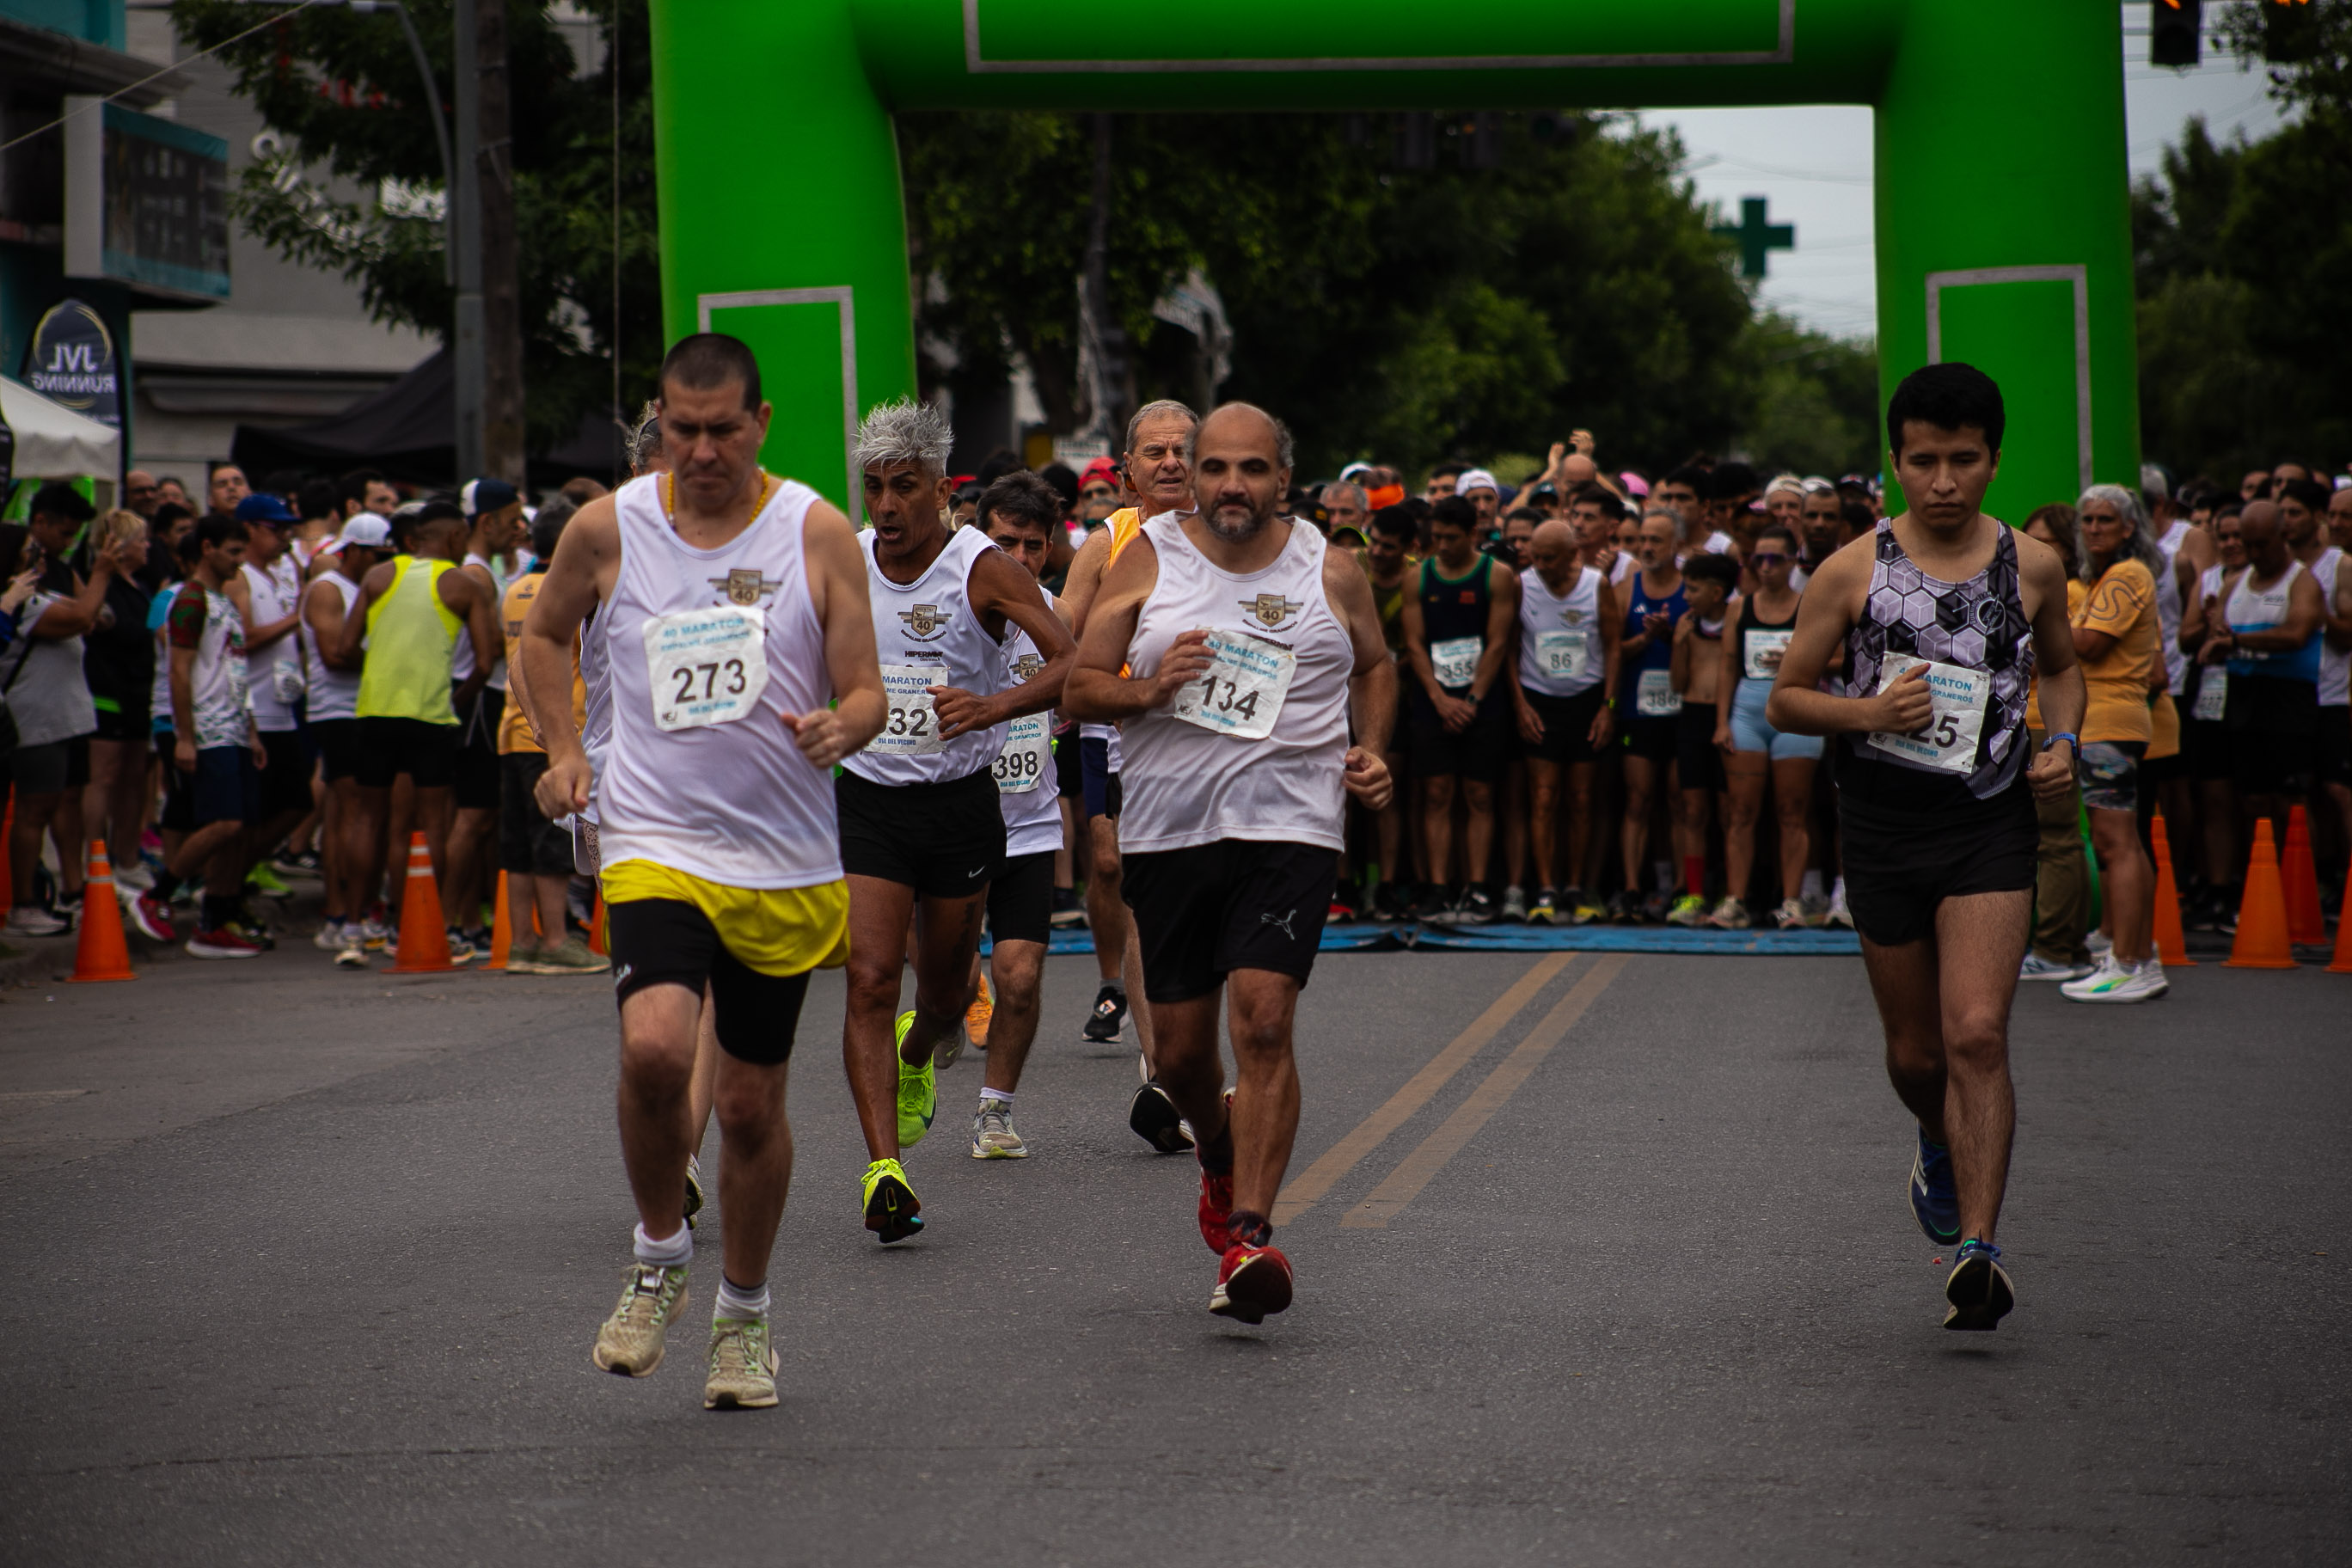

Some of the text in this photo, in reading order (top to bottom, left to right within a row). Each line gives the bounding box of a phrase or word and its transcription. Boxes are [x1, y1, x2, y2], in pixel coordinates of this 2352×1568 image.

[1263, 610, 1279, 621] 40
[916, 621, 931, 630] 40
[1225, 643, 1278, 669] MARATON
[1550, 652, 1572, 670] 86
[672, 658, 746, 704] 273
[882, 676, 932, 685] MARATON
[1024, 669, 1036, 677] 40
[1202, 675, 1259, 721] 134
[1931, 689, 1974, 703] GRANEROS
[881, 707, 928, 736] 32
[1009, 723, 1038, 732] ARATON
[992, 750, 1038, 780] 398
